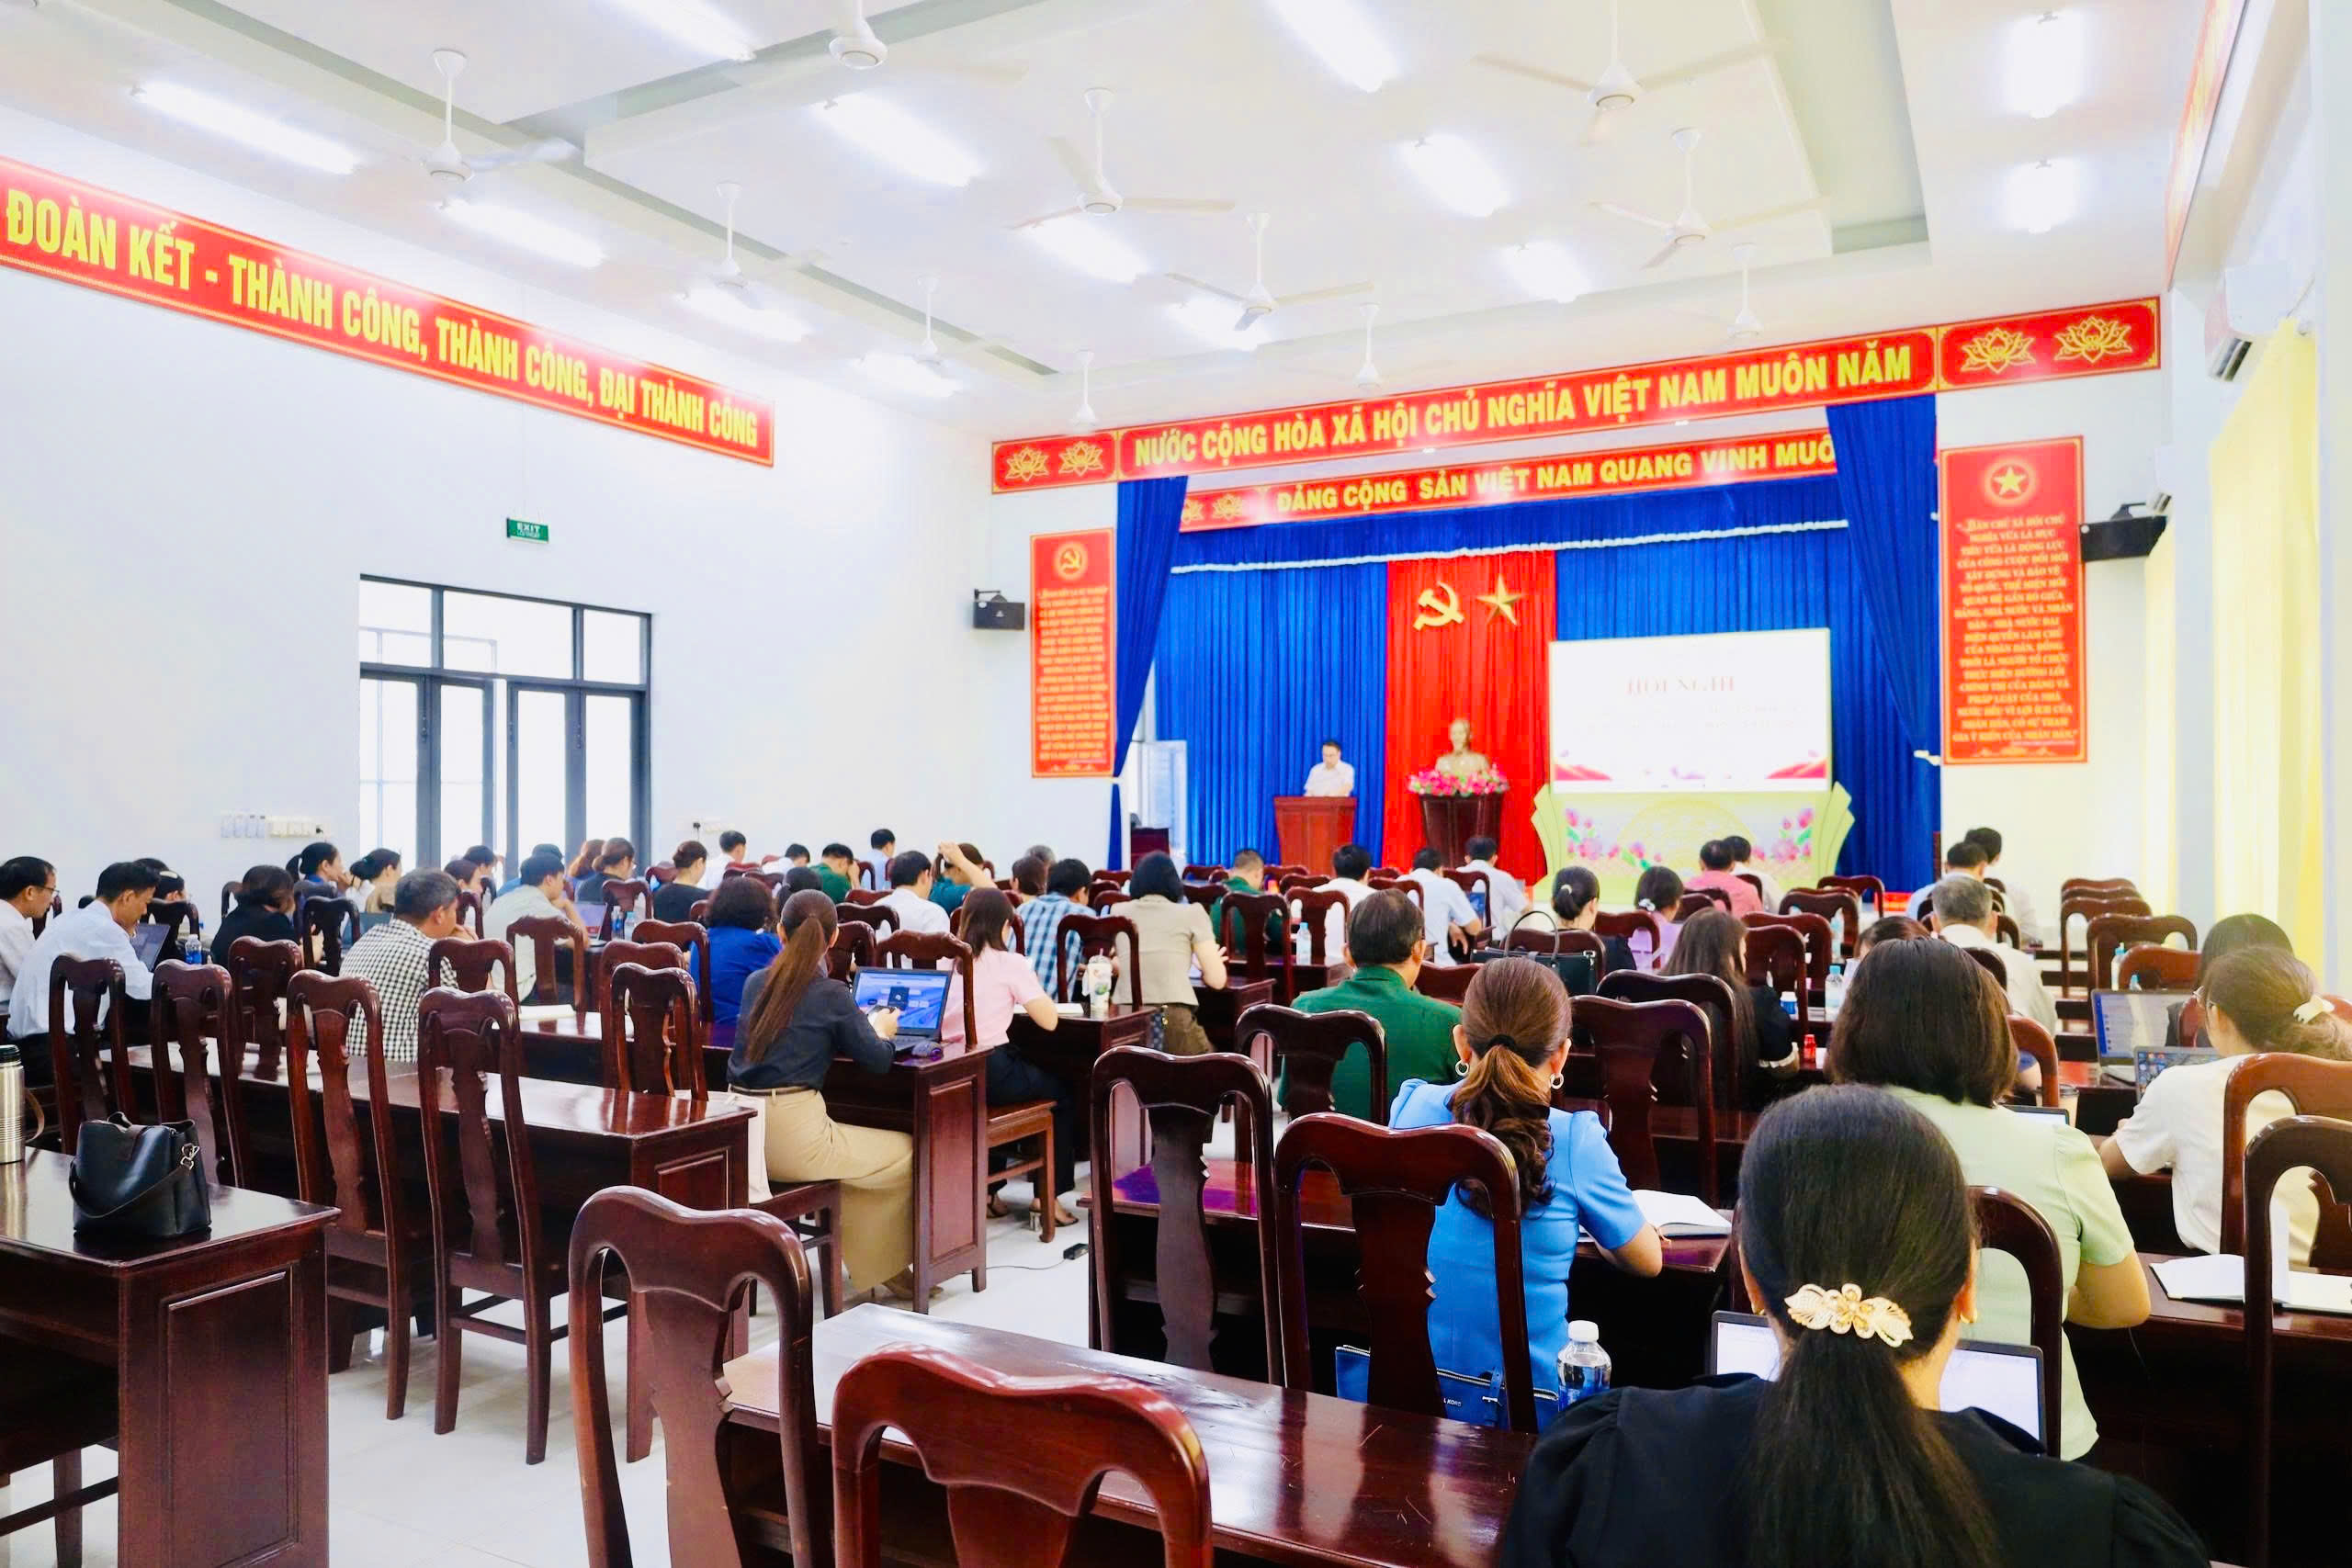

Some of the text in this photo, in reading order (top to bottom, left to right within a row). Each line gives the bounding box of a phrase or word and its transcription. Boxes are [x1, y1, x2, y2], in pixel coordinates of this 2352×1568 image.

[6, 188, 117, 270] ĐOÀN
[130, 220, 196, 289] KẾT
[228, 253, 333, 330] THÀNH
[342, 287, 428, 361] CÔNG,
[435, 316, 518, 381] THÀNH
[526, 343, 594, 408] CÔNG,
[599, 367, 635, 420] ĐẠI
[640, 379, 705, 434] THÀNH
[709, 398, 757, 447] CÔNG
[1135, 340, 1910, 467] NƯỚC CỘNG HÒA XÃ HỘI CHỦ NGHĨA VIỆT NAM MUÔN NĂM
[1277, 434, 1835, 512] ĐẢNG CỘNG SẢN VIỆT NAM QUANG VINH MUÔ
